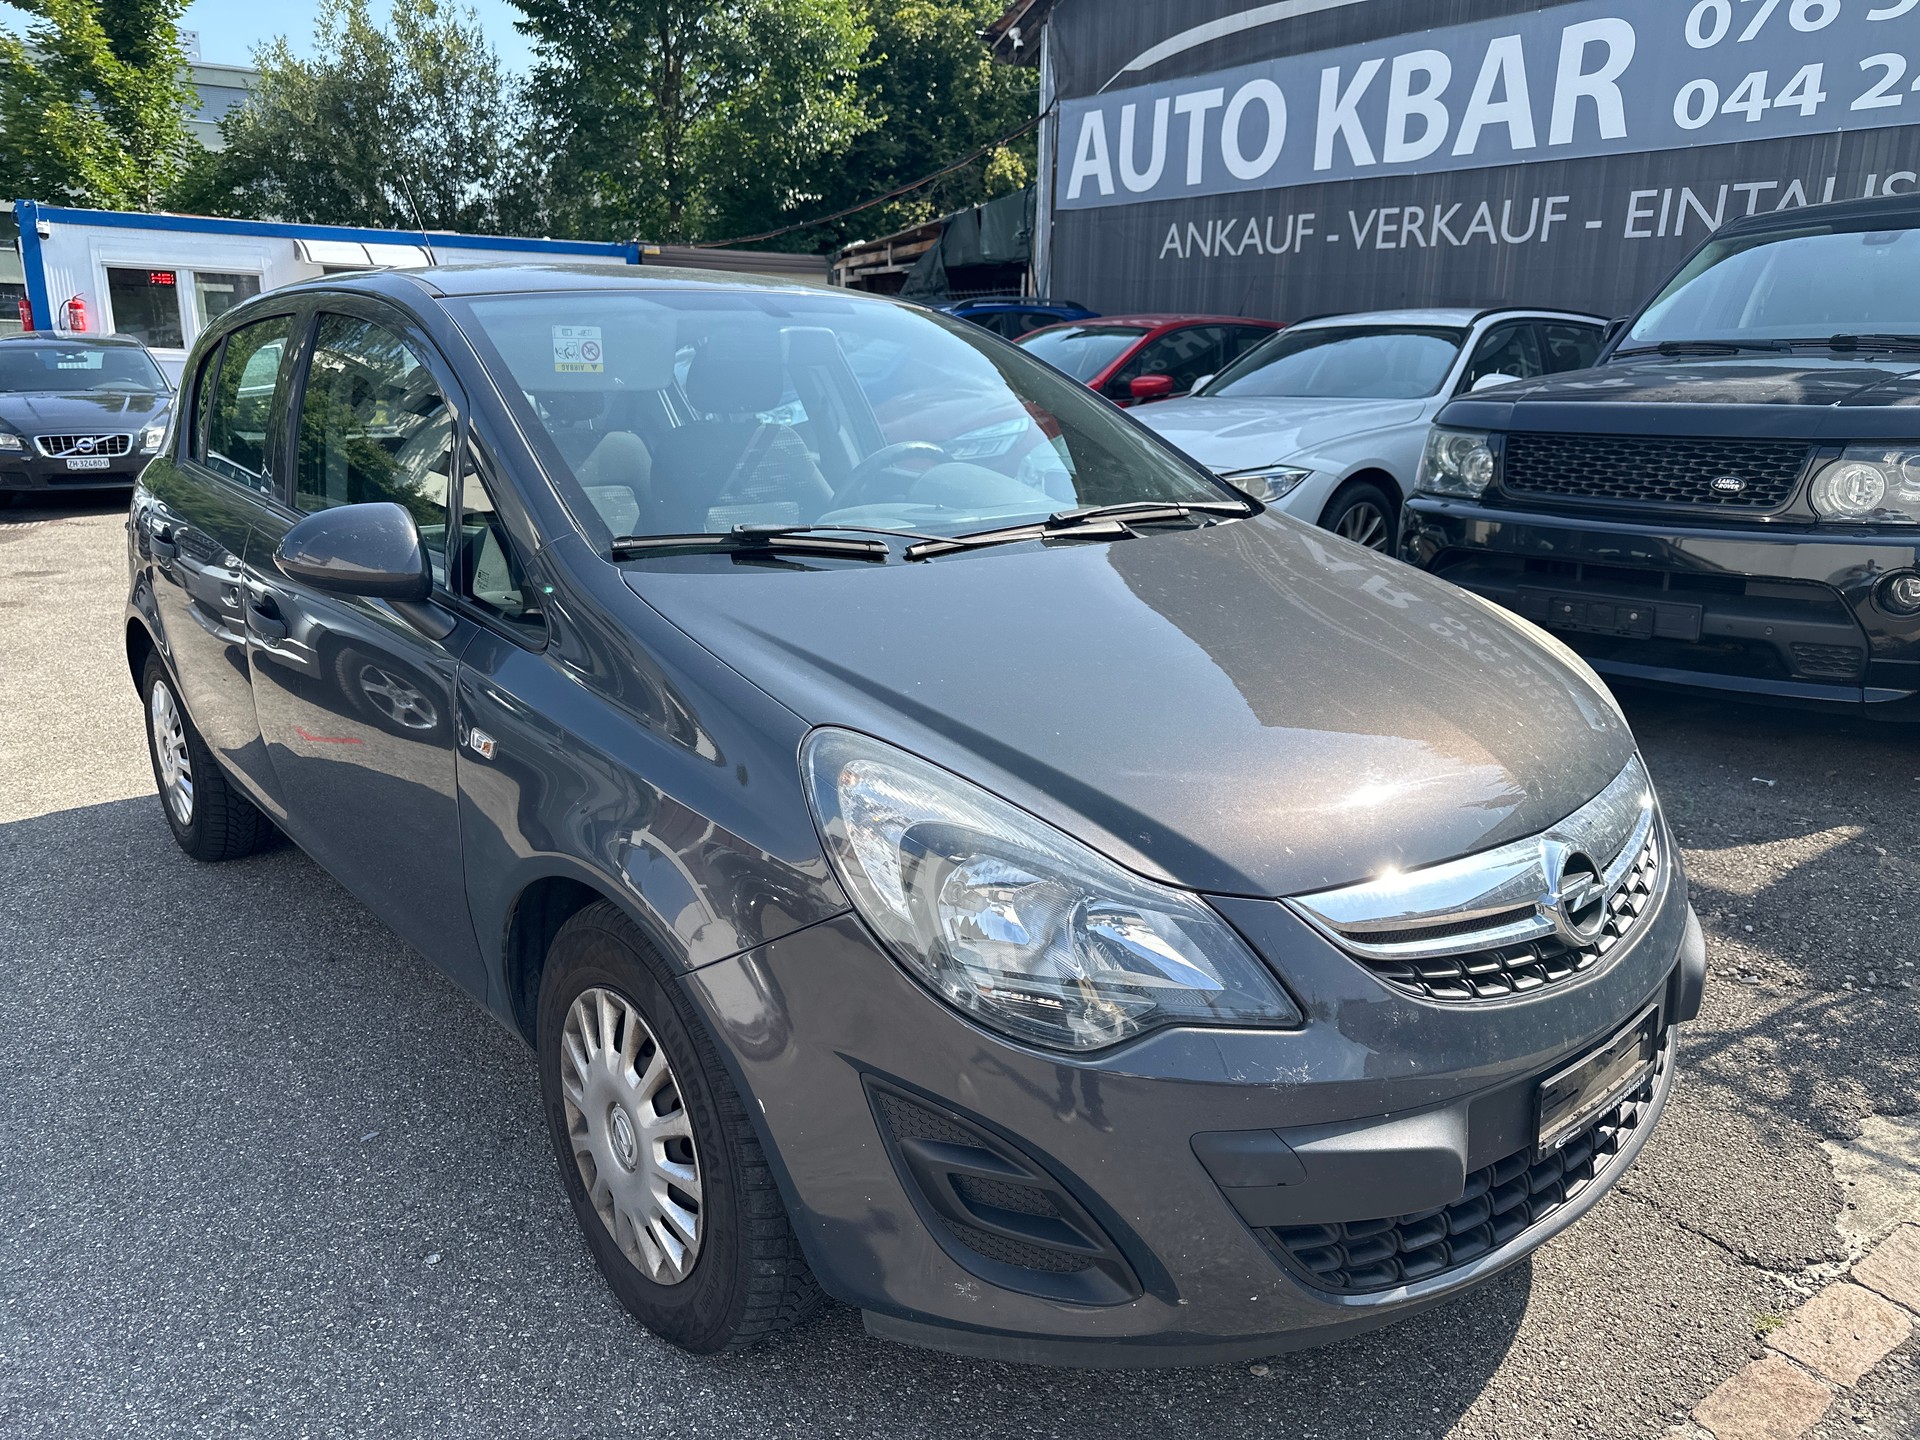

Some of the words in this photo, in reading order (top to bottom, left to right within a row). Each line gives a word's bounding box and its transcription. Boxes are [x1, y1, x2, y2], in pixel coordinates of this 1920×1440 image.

[1066, 79, 1288, 200] AUTO
[1313, 17, 1636, 171] KBAR
[1673, 62, 1828, 130] 044
[1850, 52, 1920, 111] 2
[1159, 212, 1316, 260] ANKAUF
[1348, 195, 1570, 250] VERKAUF
[663, 1018, 724, 1194] UNIROYAL
